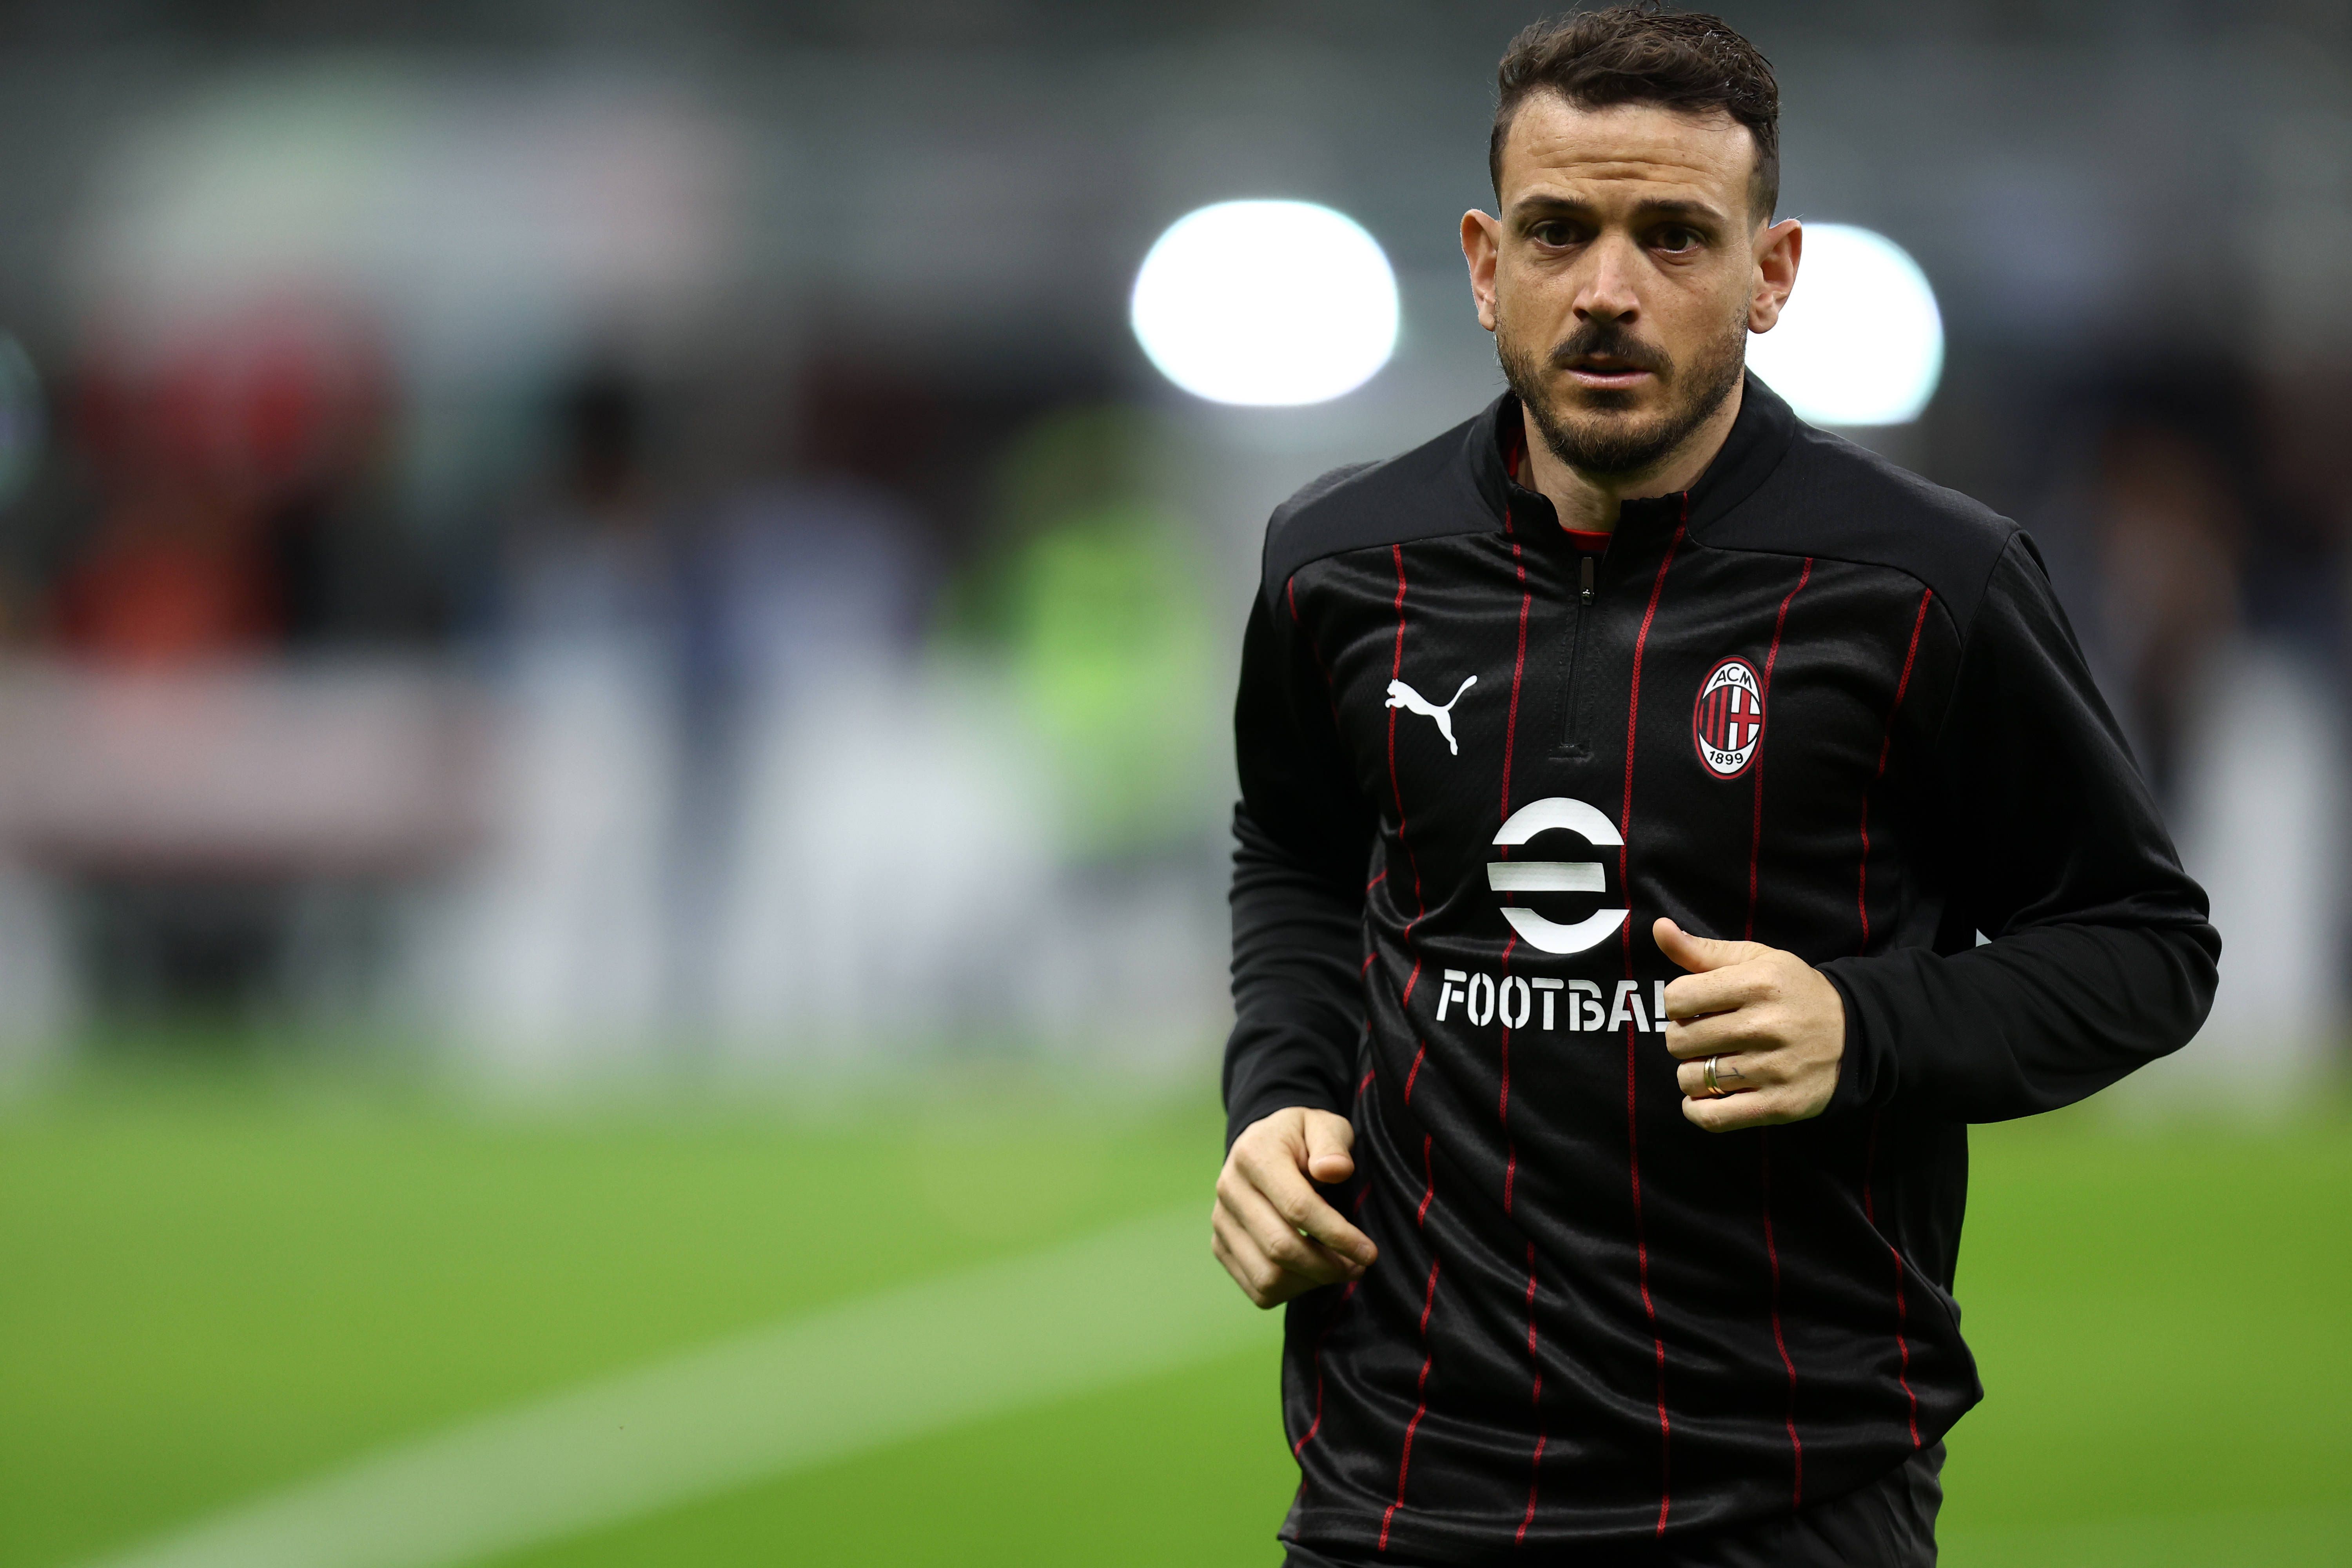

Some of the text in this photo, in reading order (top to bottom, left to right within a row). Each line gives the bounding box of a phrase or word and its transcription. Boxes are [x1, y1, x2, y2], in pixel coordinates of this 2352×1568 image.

[1712, 666, 1752, 690] ACM
[1710, 751, 1744, 765] 1899
[1436, 968, 1699, 1032] FOOTBAL
